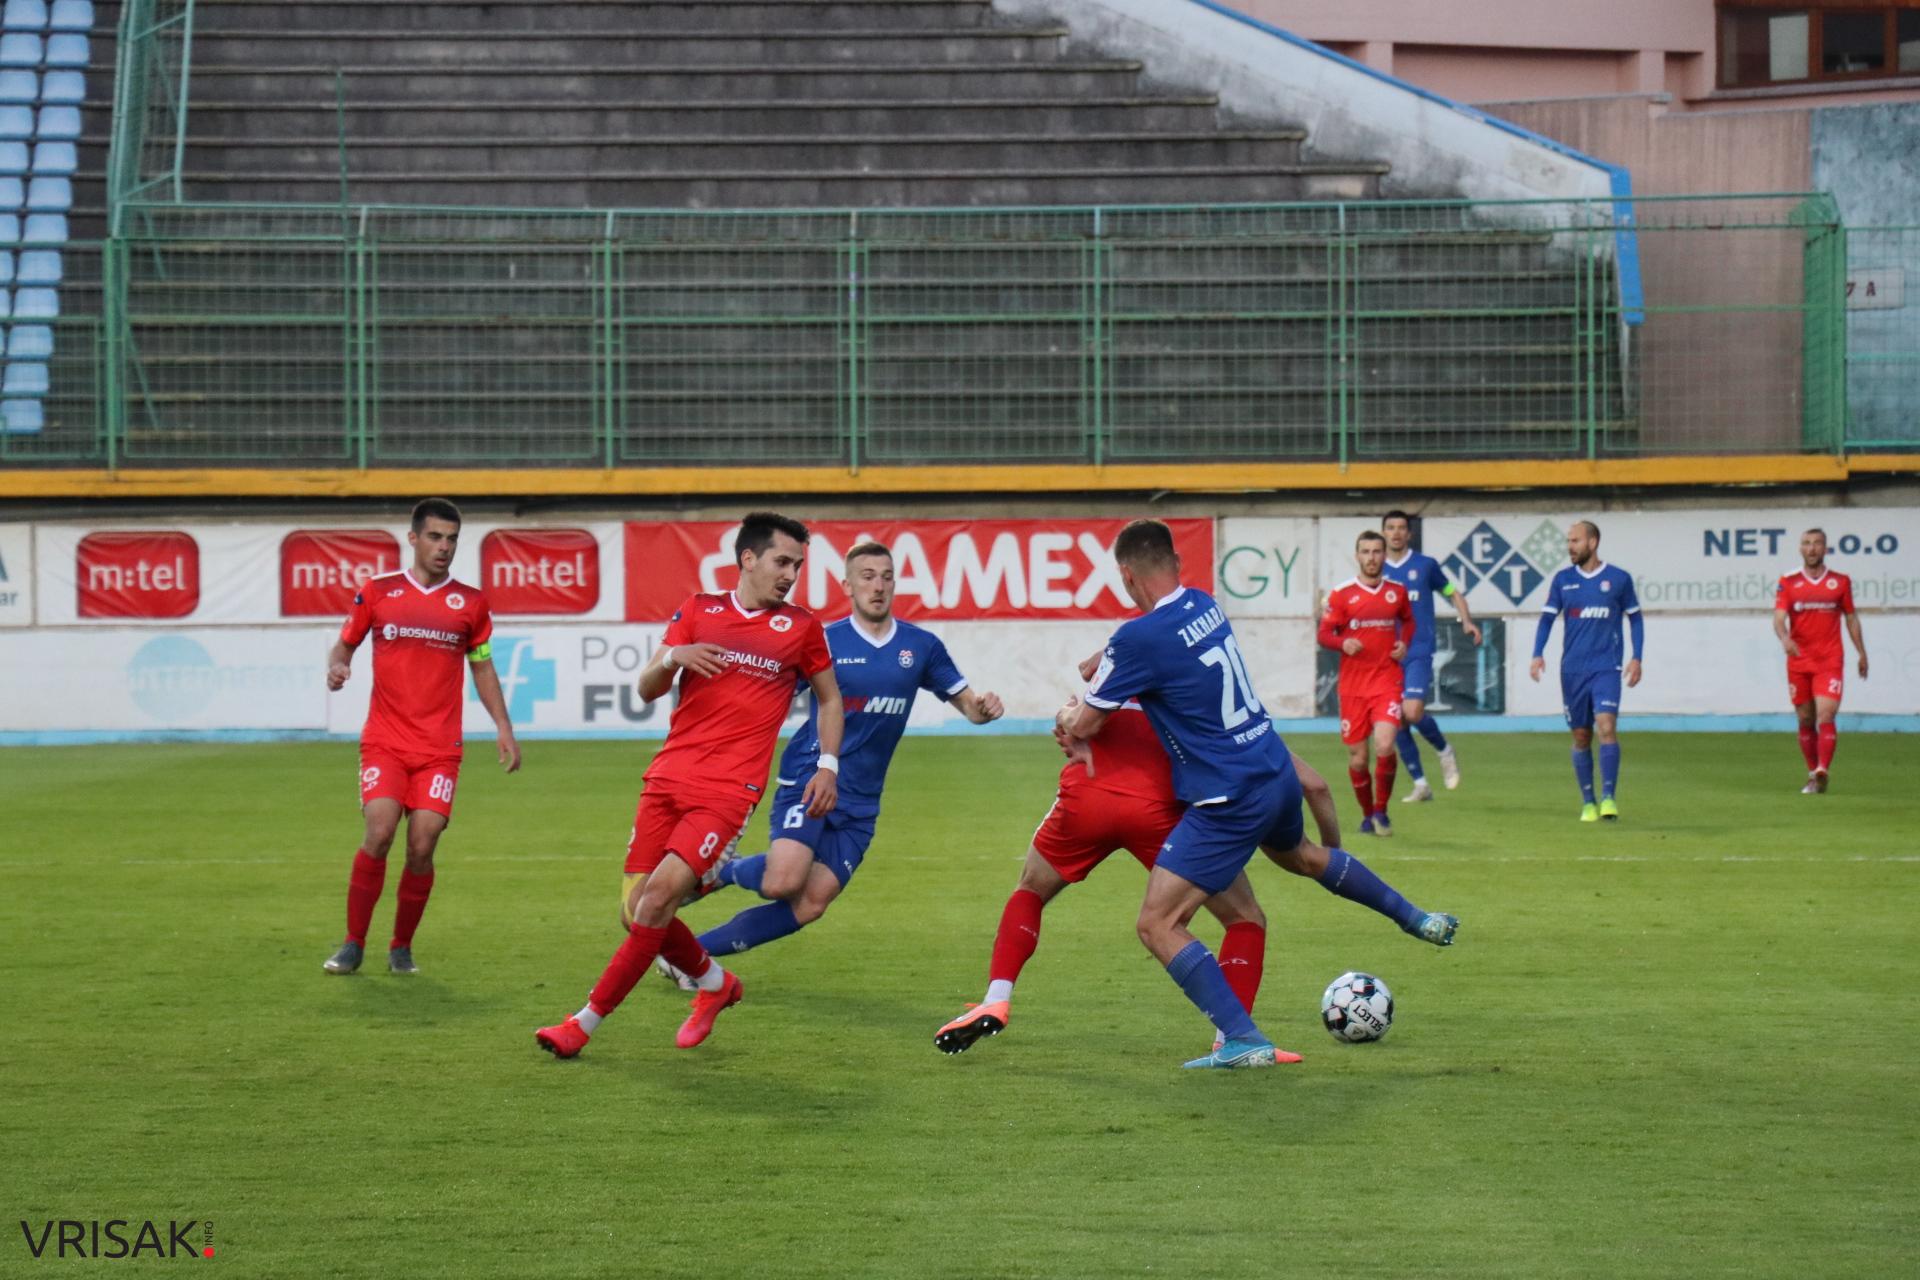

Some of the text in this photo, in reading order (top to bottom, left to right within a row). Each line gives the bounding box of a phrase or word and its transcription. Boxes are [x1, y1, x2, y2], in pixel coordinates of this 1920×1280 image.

[1703, 528, 1786, 556] NET
[89, 555, 186, 591] m:tel
[493, 552, 587, 588] m:tel
[1219, 546, 1299, 599] GY
[1198, 633, 1261, 730] 20
[429, 774, 453, 803] 88
[699, 832, 719, 859] 8
[1353, 1005, 1384, 1032] SELECT
